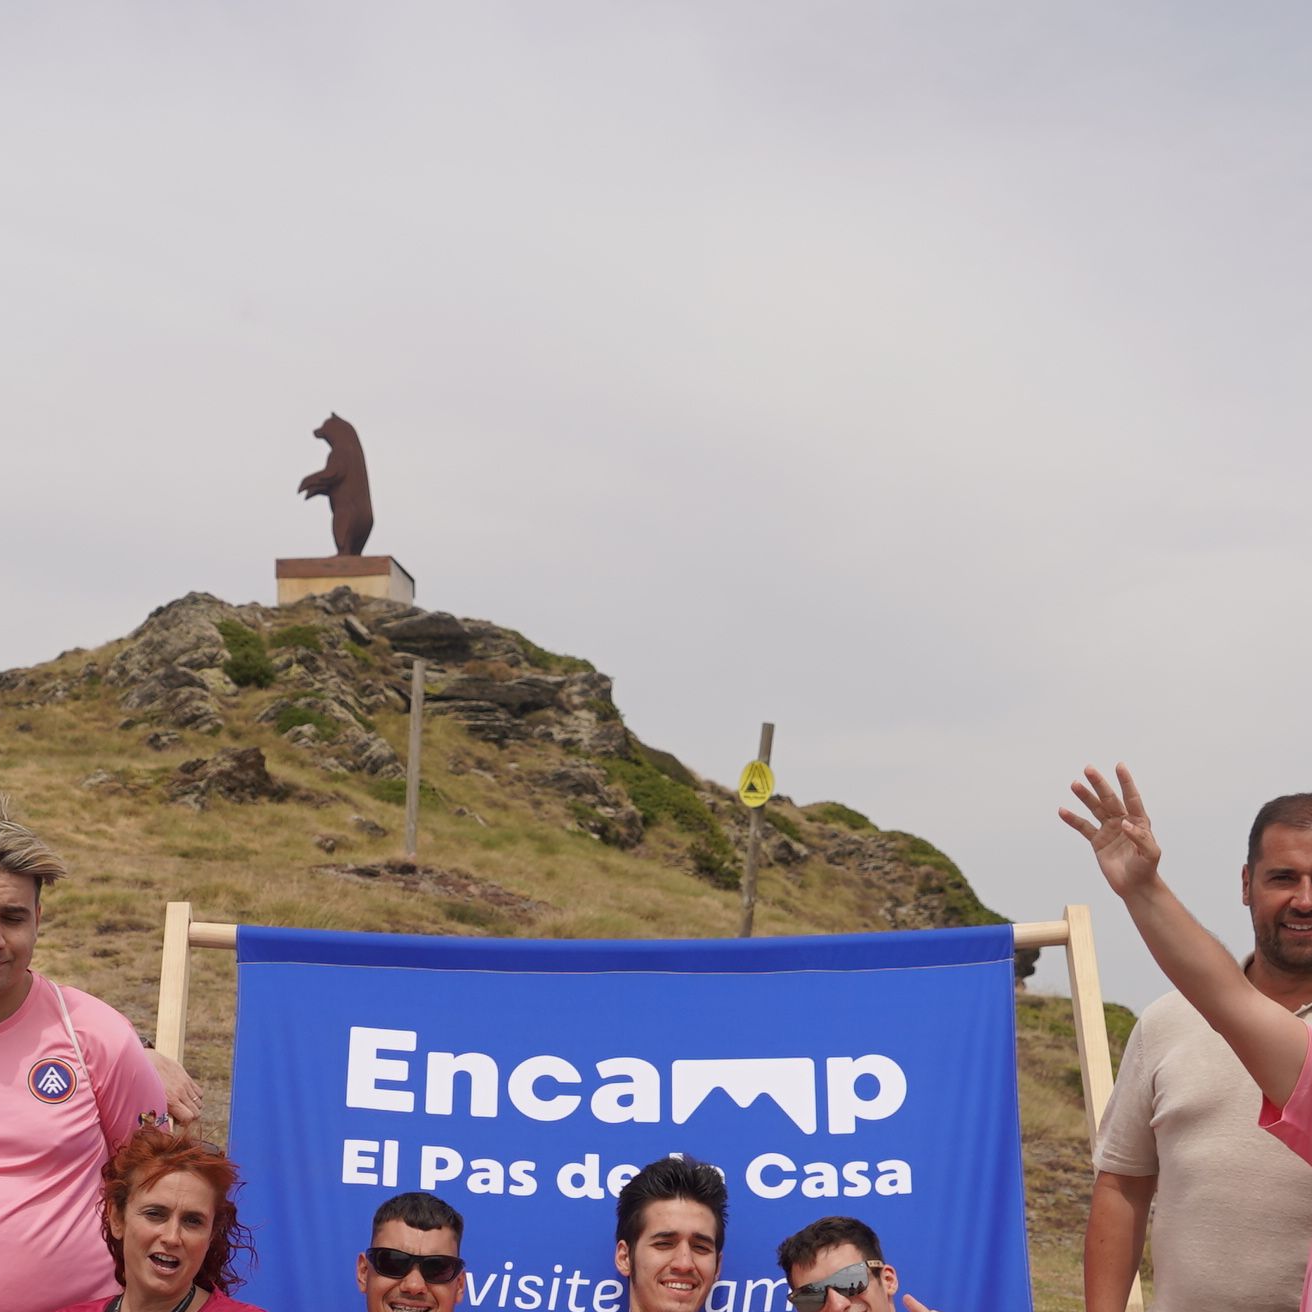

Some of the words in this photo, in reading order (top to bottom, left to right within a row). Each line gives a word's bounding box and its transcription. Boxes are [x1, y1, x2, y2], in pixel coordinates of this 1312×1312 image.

[345, 1026, 907, 1135] Encamp
[341, 1139, 399, 1187] El
[420, 1145, 538, 1196] Pas
[745, 1152, 913, 1199] Casa
